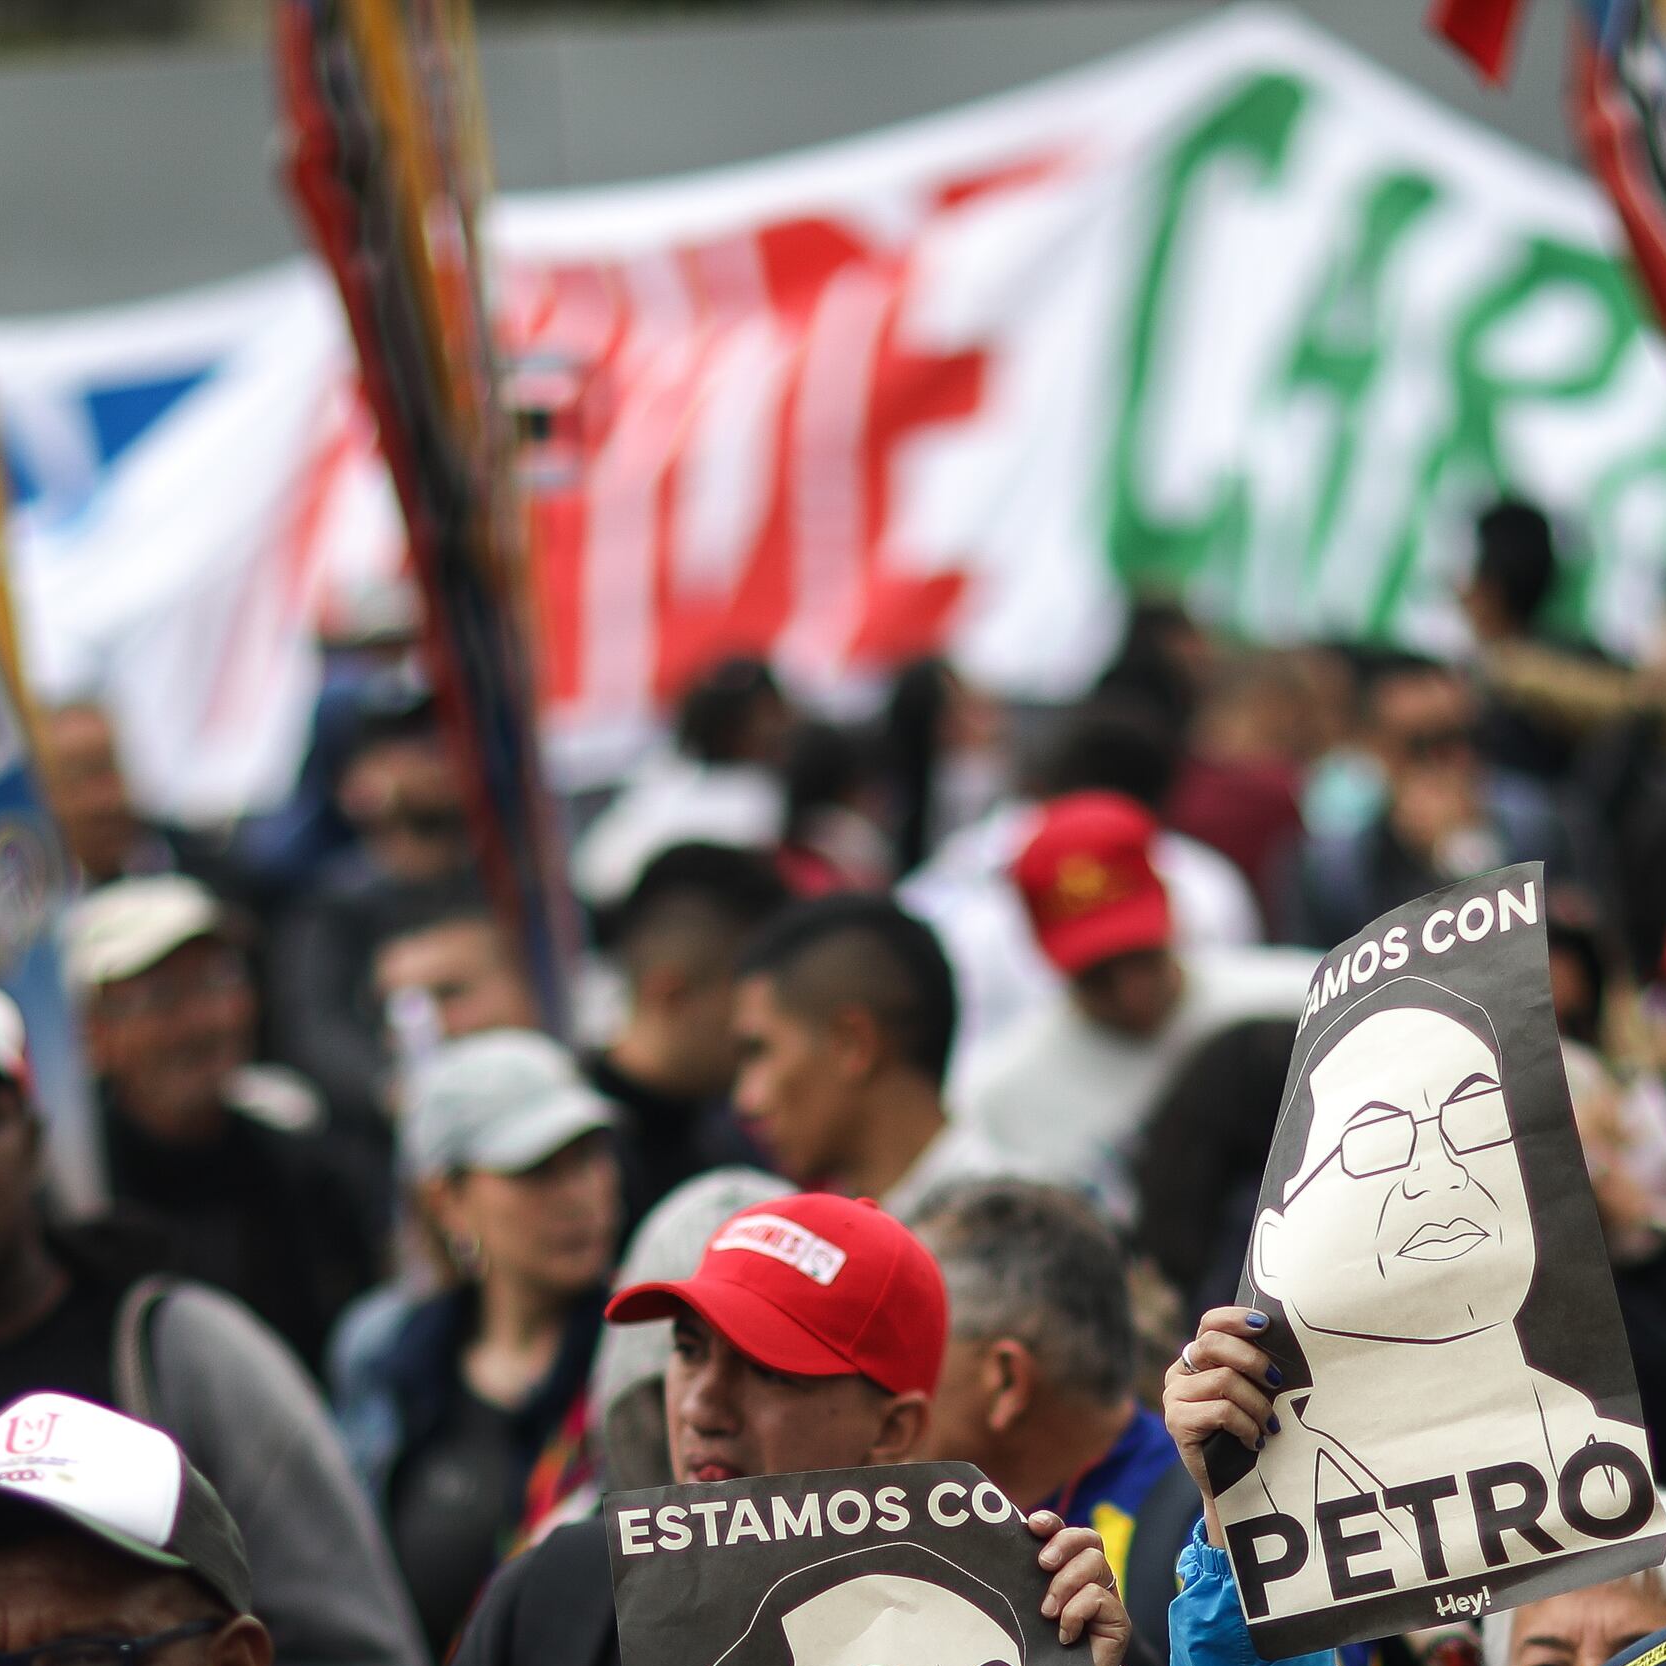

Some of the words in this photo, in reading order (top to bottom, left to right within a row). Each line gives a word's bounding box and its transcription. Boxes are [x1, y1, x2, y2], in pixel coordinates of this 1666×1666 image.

[1421, 880, 1538, 954] CON
[617, 1486, 912, 1556] ESTAMOS
[1225, 1441, 1655, 1620] PETRO
[1435, 1585, 1493, 1617] Hey!
